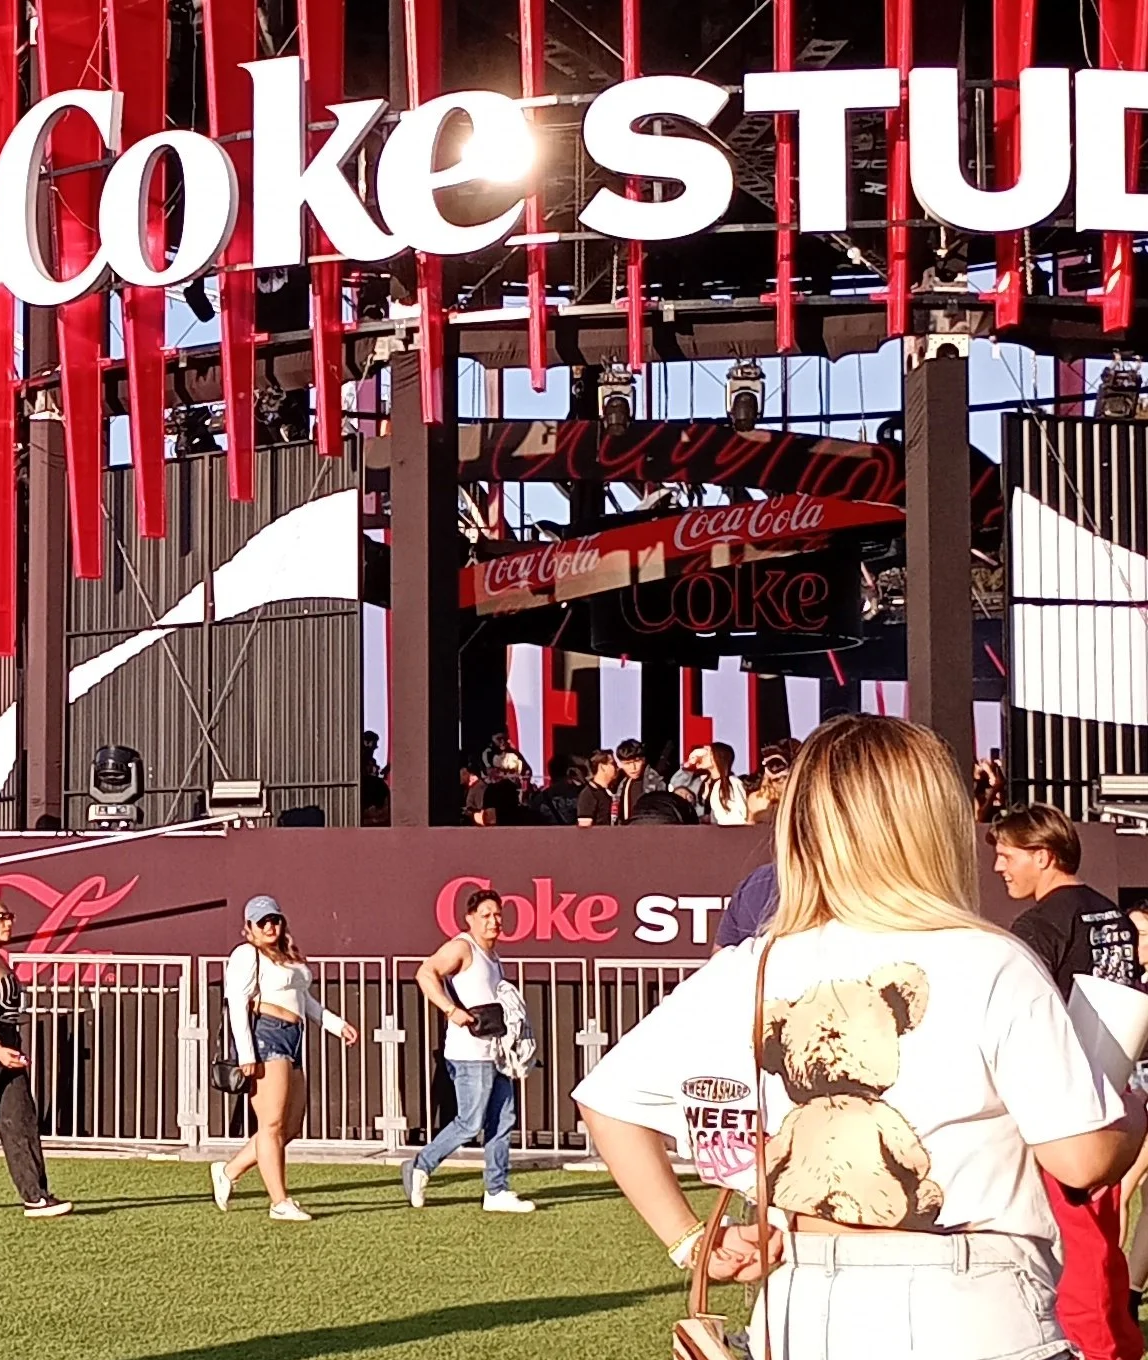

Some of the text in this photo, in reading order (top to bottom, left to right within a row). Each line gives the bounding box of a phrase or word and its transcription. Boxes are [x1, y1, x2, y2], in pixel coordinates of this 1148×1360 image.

[673, 493, 824, 551] Coca-Cola
[484, 532, 608, 596] Coca-Cola
[620, 565, 829, 634] Coke
[435, 876, 732, 944] Coke ST
